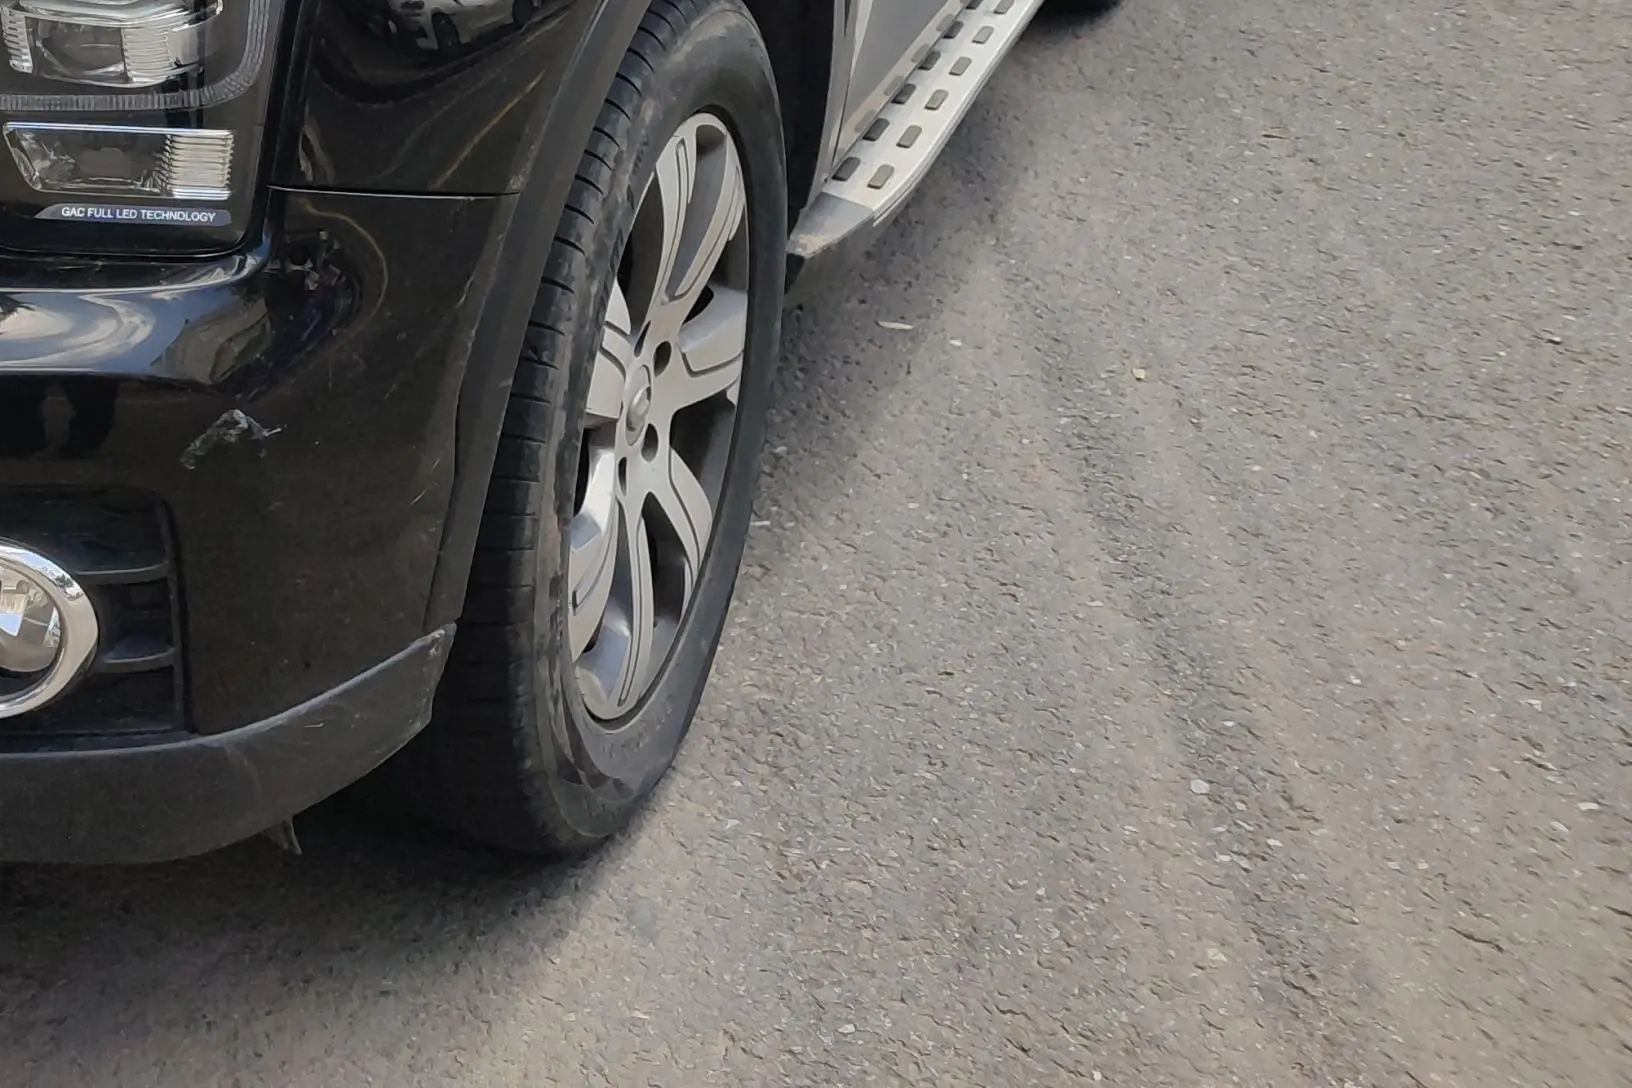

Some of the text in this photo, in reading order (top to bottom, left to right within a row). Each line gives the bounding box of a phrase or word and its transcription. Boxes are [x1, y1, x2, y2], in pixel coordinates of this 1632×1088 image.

[61, 206, 217, 223] GAC FULL LED TECHNOLOGY
